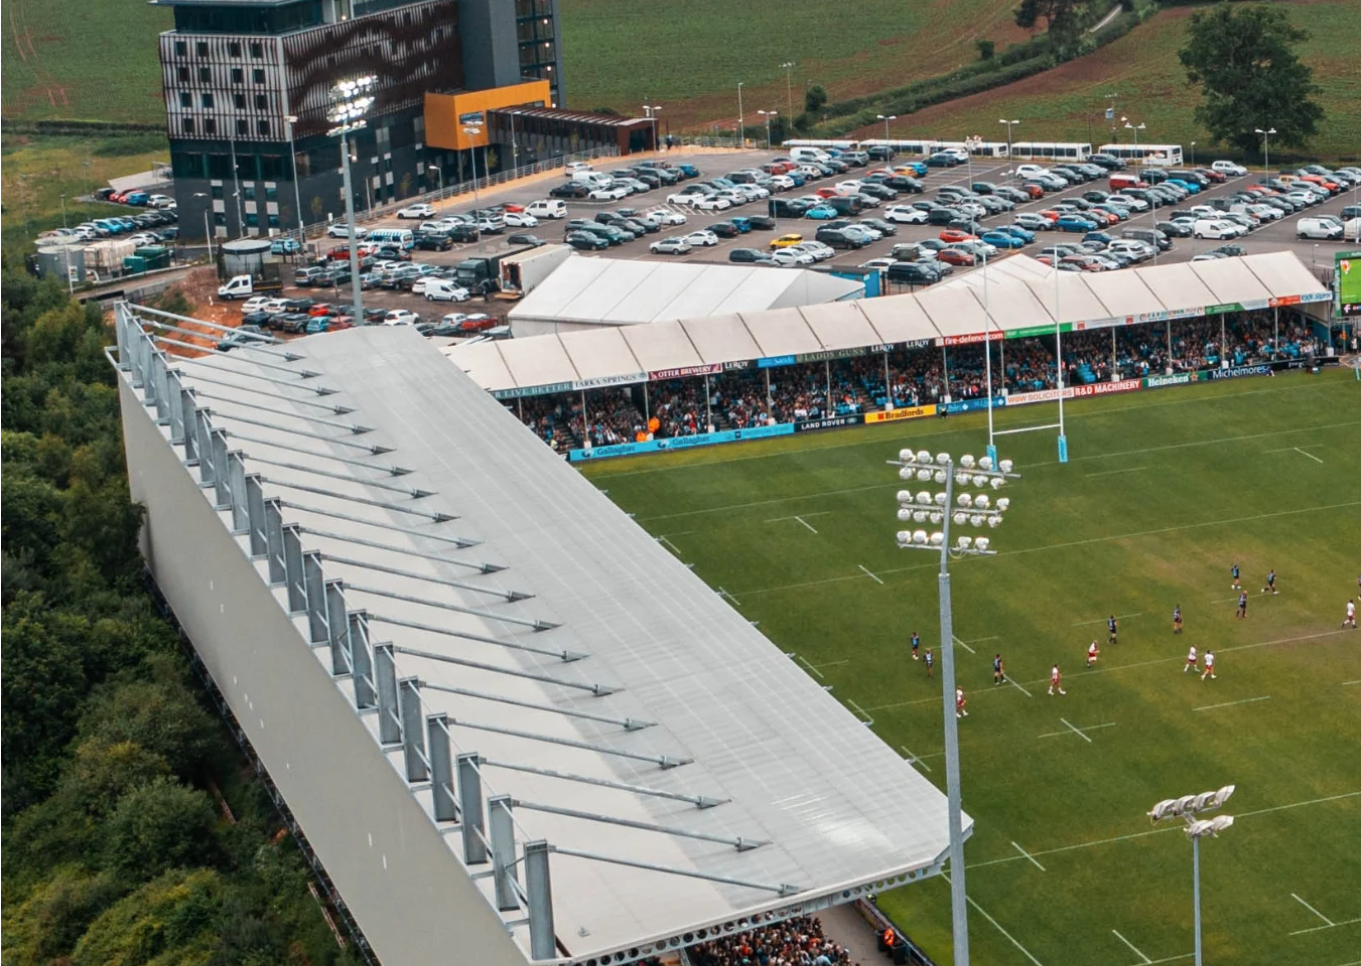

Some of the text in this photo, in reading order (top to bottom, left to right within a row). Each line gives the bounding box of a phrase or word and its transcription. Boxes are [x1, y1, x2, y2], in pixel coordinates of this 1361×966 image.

[805, 350, 834, 363] LADDS
[839, 346, 865, 357] GUNS
[658, 364, 712, 378] OTTER BREWERY
[1213, 365, 1266, 379] Michelmores
[603, 373, 637, 384] SPRINGS
[1148, 375, 1190, 387] Heineken
[504, 386, 526, 397] LIVE
[1075, 379, 1141, 396] R&D MACHINERY
[885, 408, 924, 420] Bradfords
[801, 418, 846, 431] LAND ROVER
[672, 435, 711, 447] Gallagher
[597, 445, 636, 456] Gallagher
